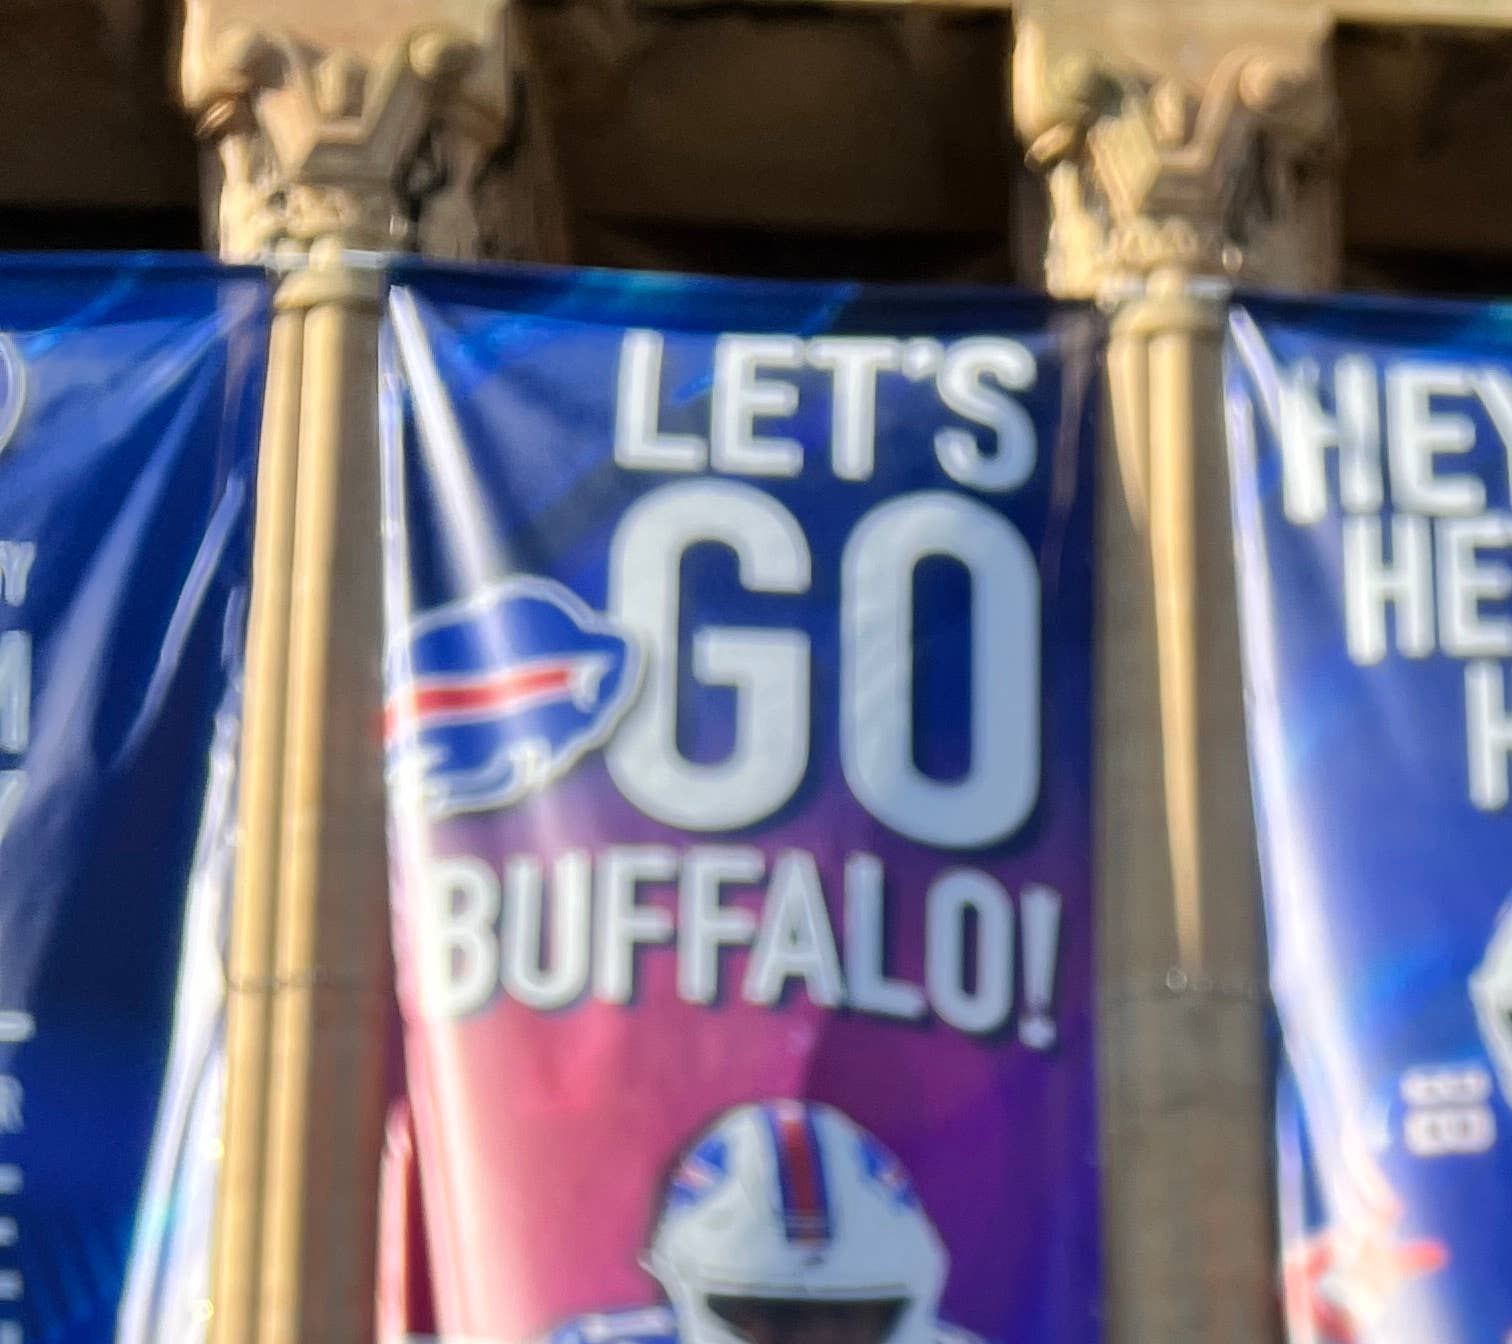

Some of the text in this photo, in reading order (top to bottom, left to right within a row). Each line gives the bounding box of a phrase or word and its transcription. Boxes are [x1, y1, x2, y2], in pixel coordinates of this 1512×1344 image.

[614, 330, 1038, 493] LET'S
[604, 479, 1041, 850] GO
[422, 844, 1062, 1051] BUFFALO!
